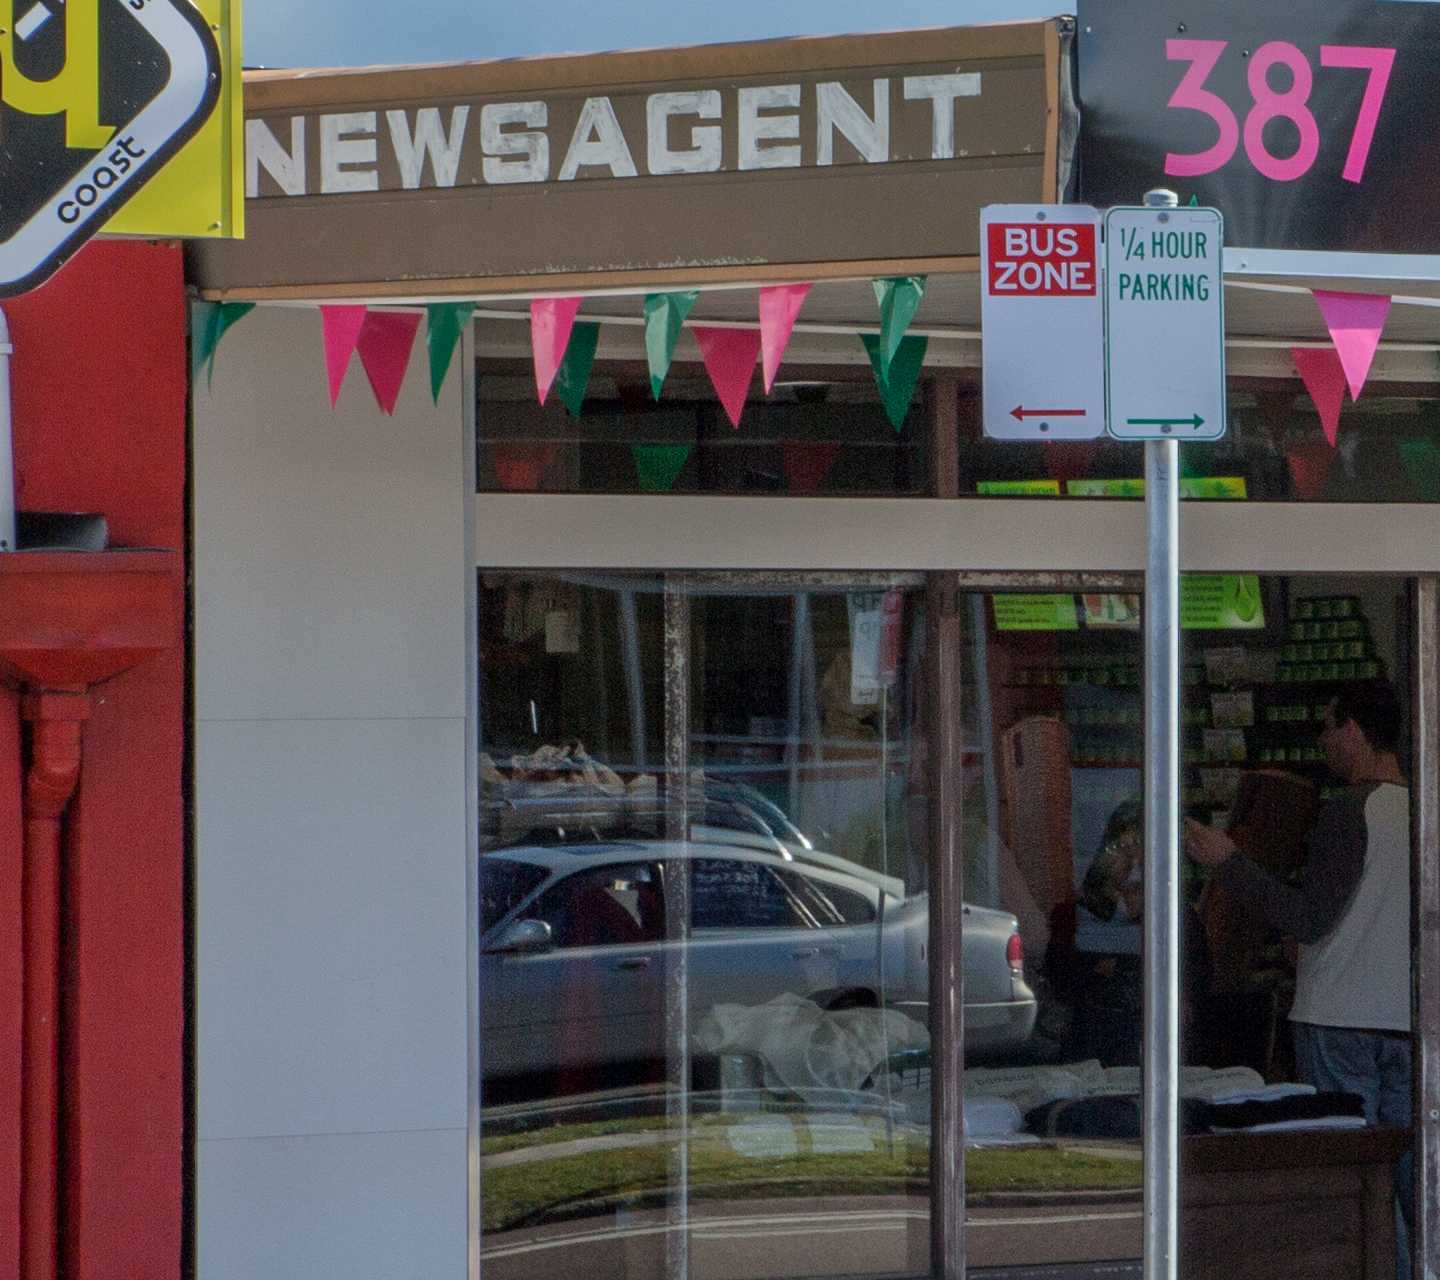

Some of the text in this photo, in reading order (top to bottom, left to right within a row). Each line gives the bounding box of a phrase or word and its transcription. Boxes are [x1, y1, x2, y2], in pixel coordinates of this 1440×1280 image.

[1164, 38, 1397, 184] 387
[246, 71, 982, 199] NEWSAGENT
[57, 134, 146, 225] coast
[1005, 227, 1079, 258] BUS
[1152, 231, 1208, 260] HOUR
[993, 261, 1096, 292] ZONE
[1118, 273, 1210, 303] PARKING
